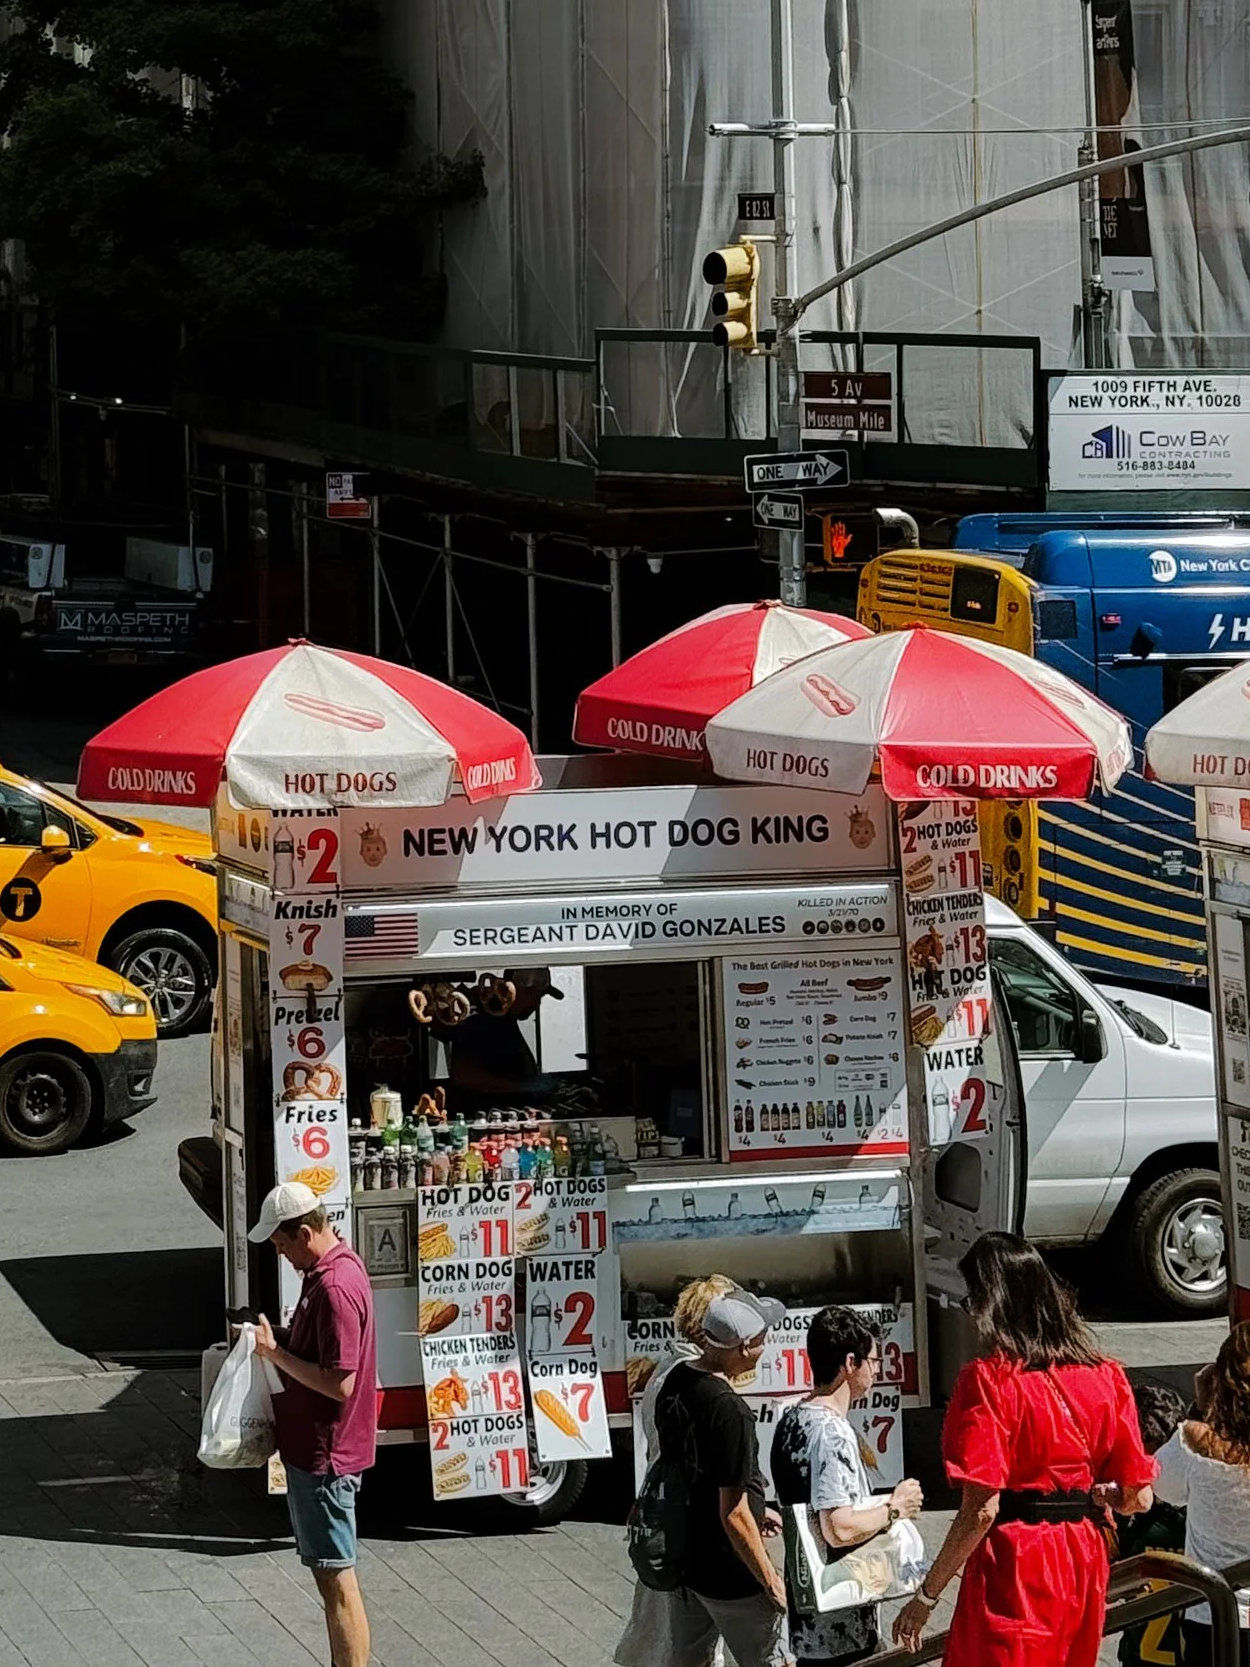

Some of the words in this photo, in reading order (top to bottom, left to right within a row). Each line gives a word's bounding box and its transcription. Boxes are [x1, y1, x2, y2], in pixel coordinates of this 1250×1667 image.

[831, 379, 839, 397] 5
[845, 380, 863, 397] Av
[1093, 380, 1128, 393] 1009
[1133, 380, 1177, 393] FIFTH
[1183, 380, 1217, 393] AVE.
[1068, 396, 1103, 408] NEW
[1197, 395, 1241, 407] 10028
[807, 410, 854, 429] Museum
[860, 411, 885, 429] Mile
[1140, 450, 1231, 459] CONTRACTING
[757, 465, 784, 480] ONE
[802, 462, 831, 477] WAY
[1117, 460, 1196, 471] 516-883-8484
[329, 476, 341, 487] NO
[761, 502, 775, 516] ONE
[783, 504, 797, 519] WAY
[1180, 559, 1208, 572] New
[1209, 559, 1239, 572] York
[87, 612, 190, 626] MASPETH
[87, 625, 191, 635] ROOFING
[746, 748, 776, 770] HOT
[782, 754, 830, 778] DOGS
[1193, 754, 1228, 775] HOT
[107, 767, 145, 793] COLD
[145, 768, 197, 795] DRINKS
[284, 773, 329, 794] HOT
[336, 772, 397, 793] DOGS
[402, 825, 479, 858] NEW
[487, 823, 578, 854] YORK
[589, 821, 657, 850] HOT
[668, 817, 741, 847] DOG
[751, 814, 830, 844] KING
[902, 827, 918, 854] 2
[917, 823, 943, 841] HOT
[945, 819, 978, 837] DOGS
[931, 839, 940, 850] &
[942, 836, 972, 849] Water
[297, 829, 339, 884] $2
[949, 850, 981, 889] $11
[10, 887, 33, 918] T
[274, 899, 338, 920] Knish
[798, 896, 833, 908] KILLED
[835, 896, 845, 907] IN
[846, 895, 888, 906] ACTION
[561, 907, 577, 920] IN
[581, 904, 652, 919] MEMORY
[657, 903, 678, 917] OF
[913, 914, 936, 927] Fries
[939, 913, 948, 924] &
[949, 910, 979, 922] Water
[285, 923, 322, 956] $7
[453, 924, 579, 947] SERGEANT
[584, 920, 656, 941] DAVID
[662, 915, 786, 938] GONZALES
[954, 927, 987, 964] $13
[731, 962, 748, 971] The
[750, 961, 769, 971] Best
[770, 960, 800, 970] Grilled
[801, 959, 818, 969] Hot
[819, 959, 841, 971] Dogs
[842, 958, 851, 967] in
[852, 957, 873, 967] New
[874, 956, 894, 966] York
[800, 978, 811, 987] All
[812, 978, 829, 987] Beef
[950, 966, 987, 984] DOG
[736, 999, 764, 1009] Regular
[765, 996, 776, 1007] $5
[853, 993, 877, 1002] Jumbo
[878, 991, 888, 1002] $9
[288, 1027, 326, 1059] $6
[927, 1047, 984, 1072] WATER
[285, 1105, 338, 1125] Fries
[421, 1186, 464, 1207] HOT
[468, 1184, 511, 1204] DOG
[378, 1228, 397, 1253] A
[421, 1264, 470, 1283] CORN
[475, 1261, 514, 1279] DOG
[529, 1260, 596, 1283] WATER
[422, 1338, 468, 1358] CHICKEN
[470, 1335, 516, 1353] TENDERS
[767, 1331, 801, 1345] Water
[530, 1360, 566, 1378] Corn
[568, 1359, 599, 1380] Dog
[870, 1394, 900, 1412] Dog
